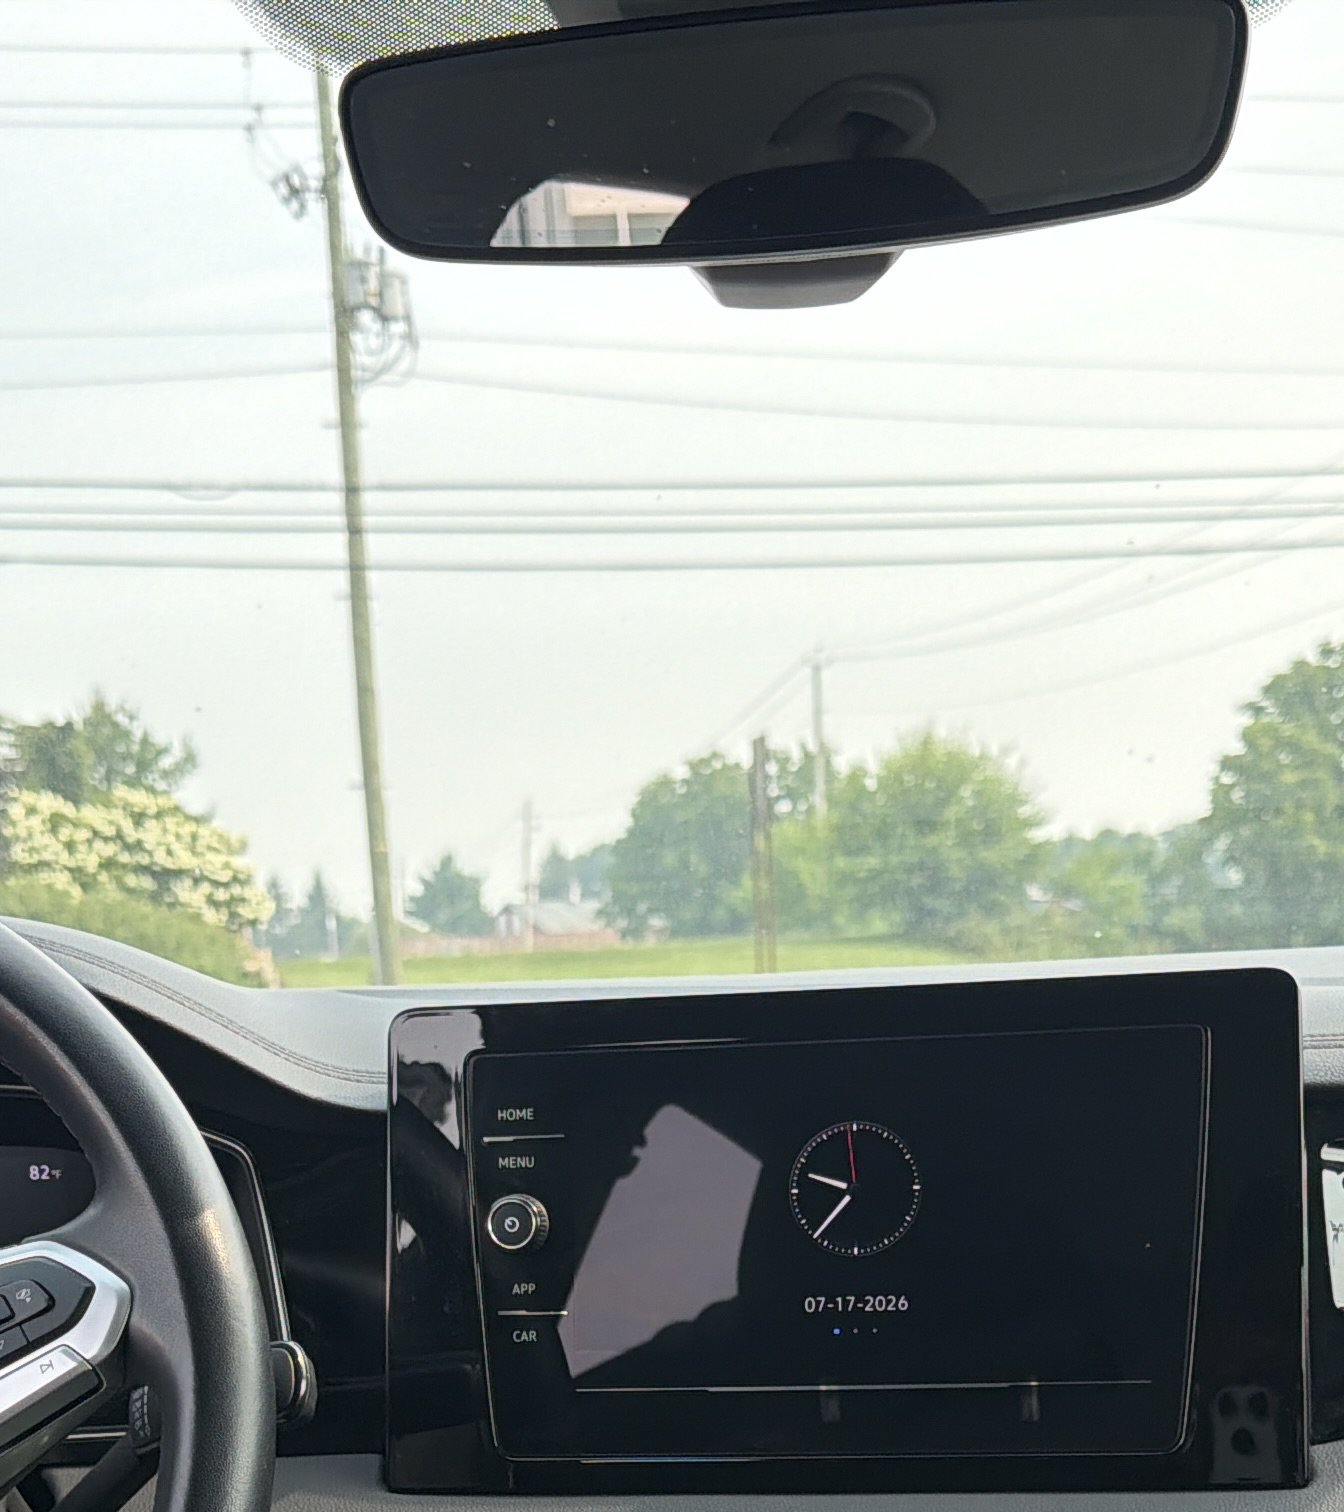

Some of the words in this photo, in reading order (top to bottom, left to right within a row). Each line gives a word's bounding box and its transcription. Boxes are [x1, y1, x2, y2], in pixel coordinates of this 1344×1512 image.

[497, 1108, 535, 1121] HOME
[498, 1156, 535, 1169] MENU
[512, 1282, 536, 1295] APP
[804, 1295, 909, 1313] 07-17-2026
[512, 1330, 538, 1343] CAR
